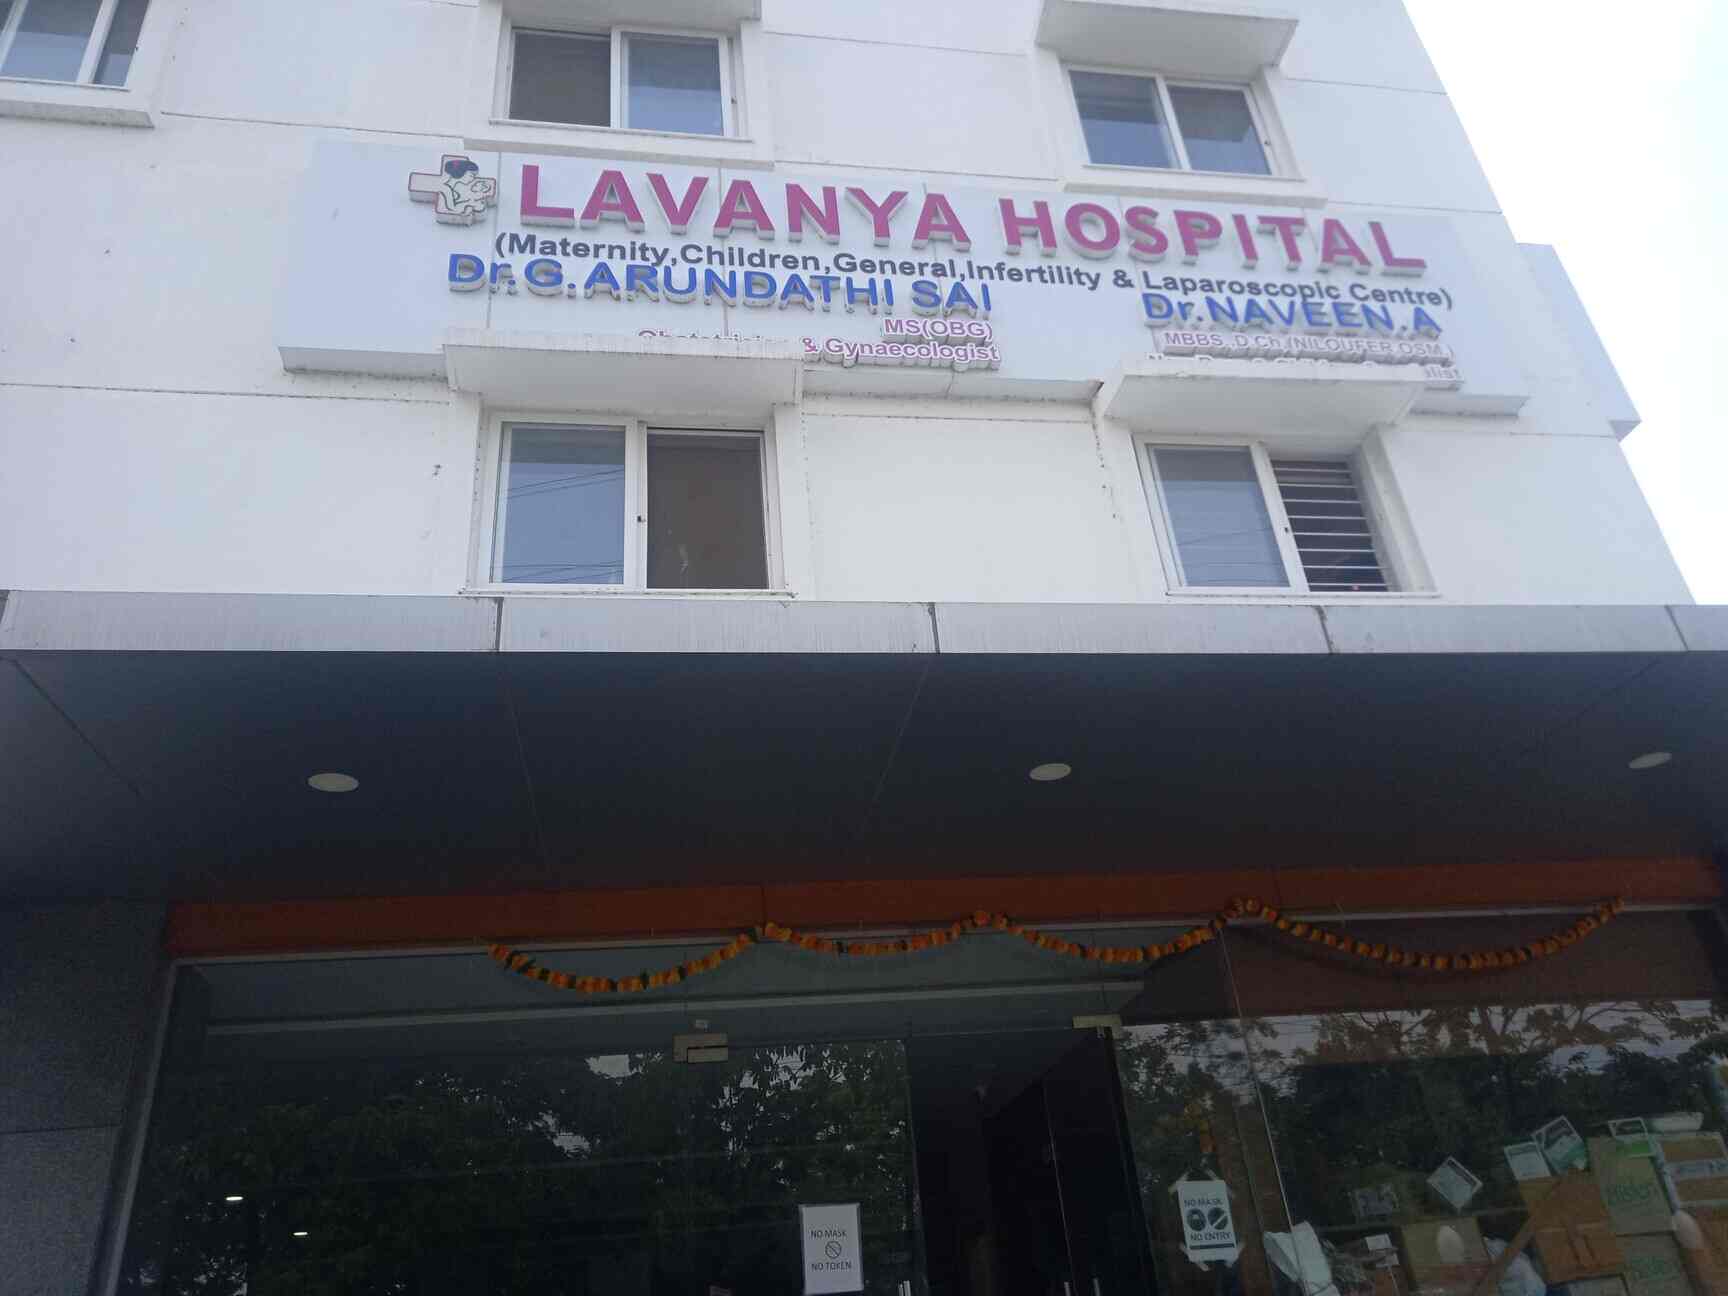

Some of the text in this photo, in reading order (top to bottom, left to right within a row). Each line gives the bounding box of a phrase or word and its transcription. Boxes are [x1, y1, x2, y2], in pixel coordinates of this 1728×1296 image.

[520, 163, 1428, 275] LAVANYA HOSPITAL
[911, 278, 992, 319] SAI
[1112, 268, 1135, 289] &
[1142, 269, 1340, 304] Laparoscopic
[1351, 281, 1453, 311] Centre)
[884, 319, 994, 339] MS(OBG)
[801, 336, 818, 353] &
[825, 338, 1001, 363] Gynaecologist
[1183, 1198, 1223, 1207] NO MASK
[810, 1230, 847, 1239] NO MASK
[1190, 1231, 1232, 1241] NO ENTRY
[811, 1261, 852, 1271] NO TOKEN
